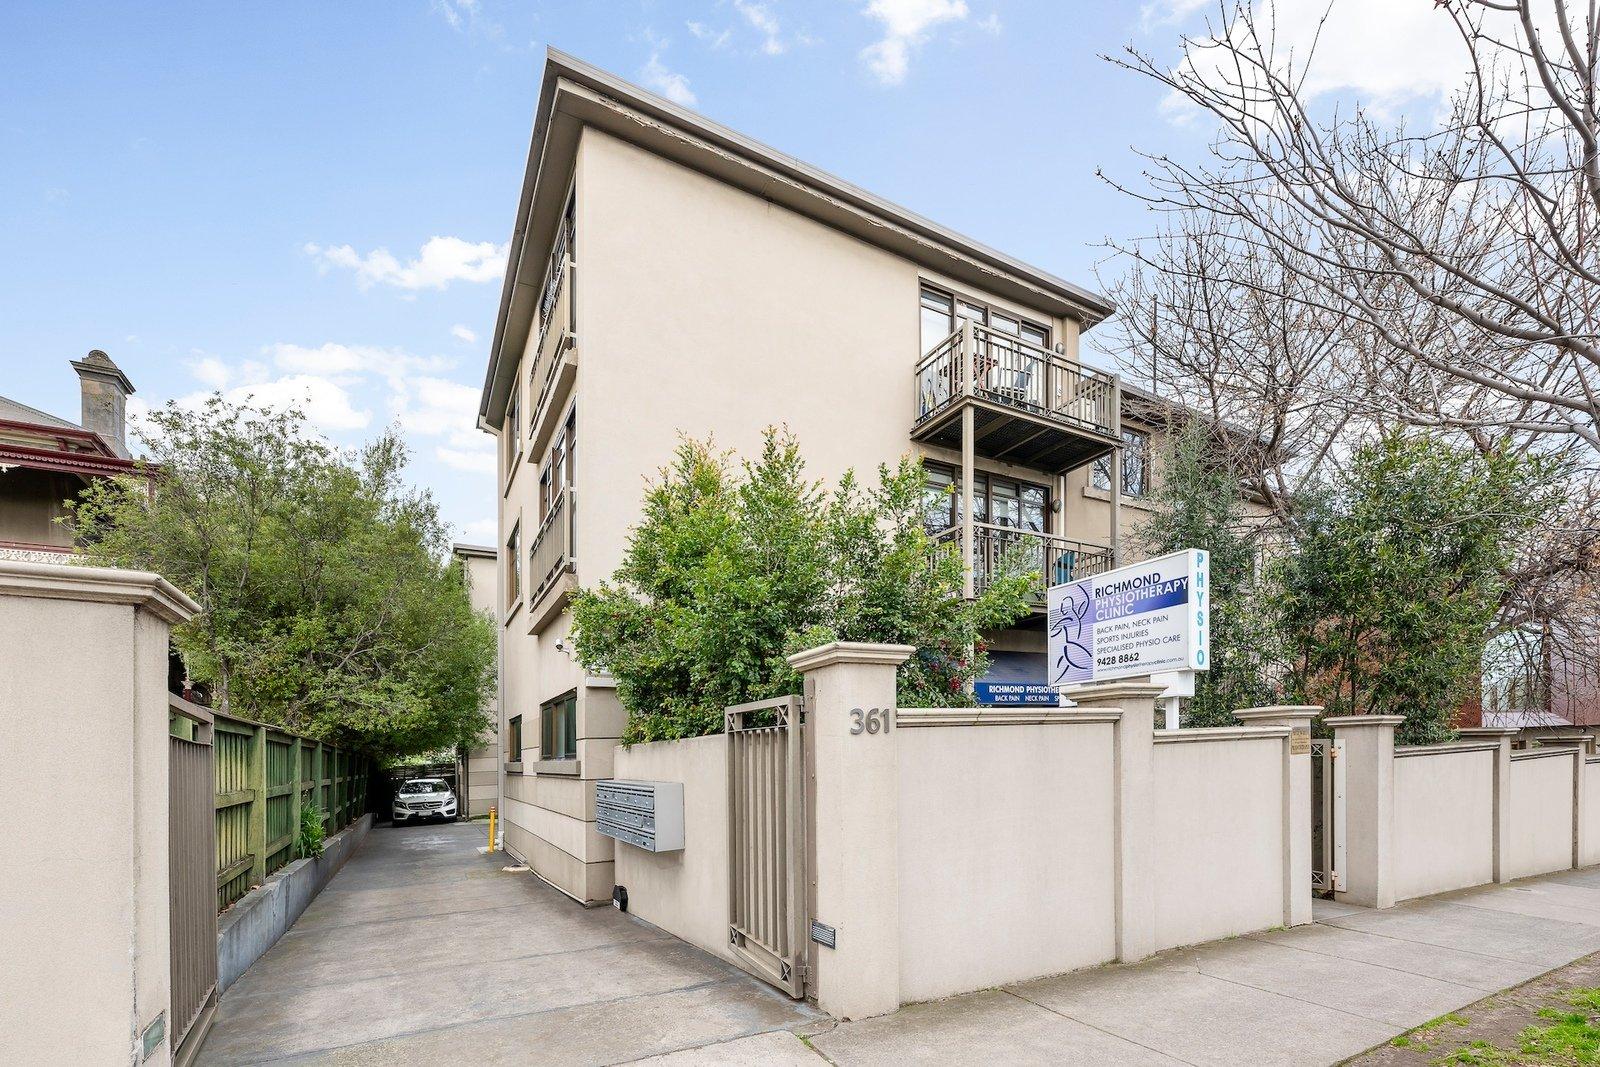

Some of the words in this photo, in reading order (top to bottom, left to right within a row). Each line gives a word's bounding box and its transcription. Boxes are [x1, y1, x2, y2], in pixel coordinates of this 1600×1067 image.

[1095, 572, 1161, 599] RICHMOND
[1095, 578, 1188, 610] PHYSIOTHERAPY
[1095, 603, 1134, 621] CLINIC
[1196, 552, 1204, 665] PHYSIO
[1096, 626, 1113, 635] BACK
[1114, 622, 1130, 632] PAIN,
[1132, 618, 1151, 628] NECK
[1152, 614, 1169, 624] PAIN
[1096, 635, 1120, 645] SPORTS
[1120, 629, 1149, 641] INJURIES
[1096, 643, 1134, 655] SPECIALISED
[1135, 638, 1161, 648] PHYSIO
[1162, 634, 1181, 644] CARE
[1096, 656, 1117, 667] 9428
[1118, 652, 1140, 664] 8862
[988, 685, 1025, 693] RICHMOND
[849, 707, 890, 735] 361
